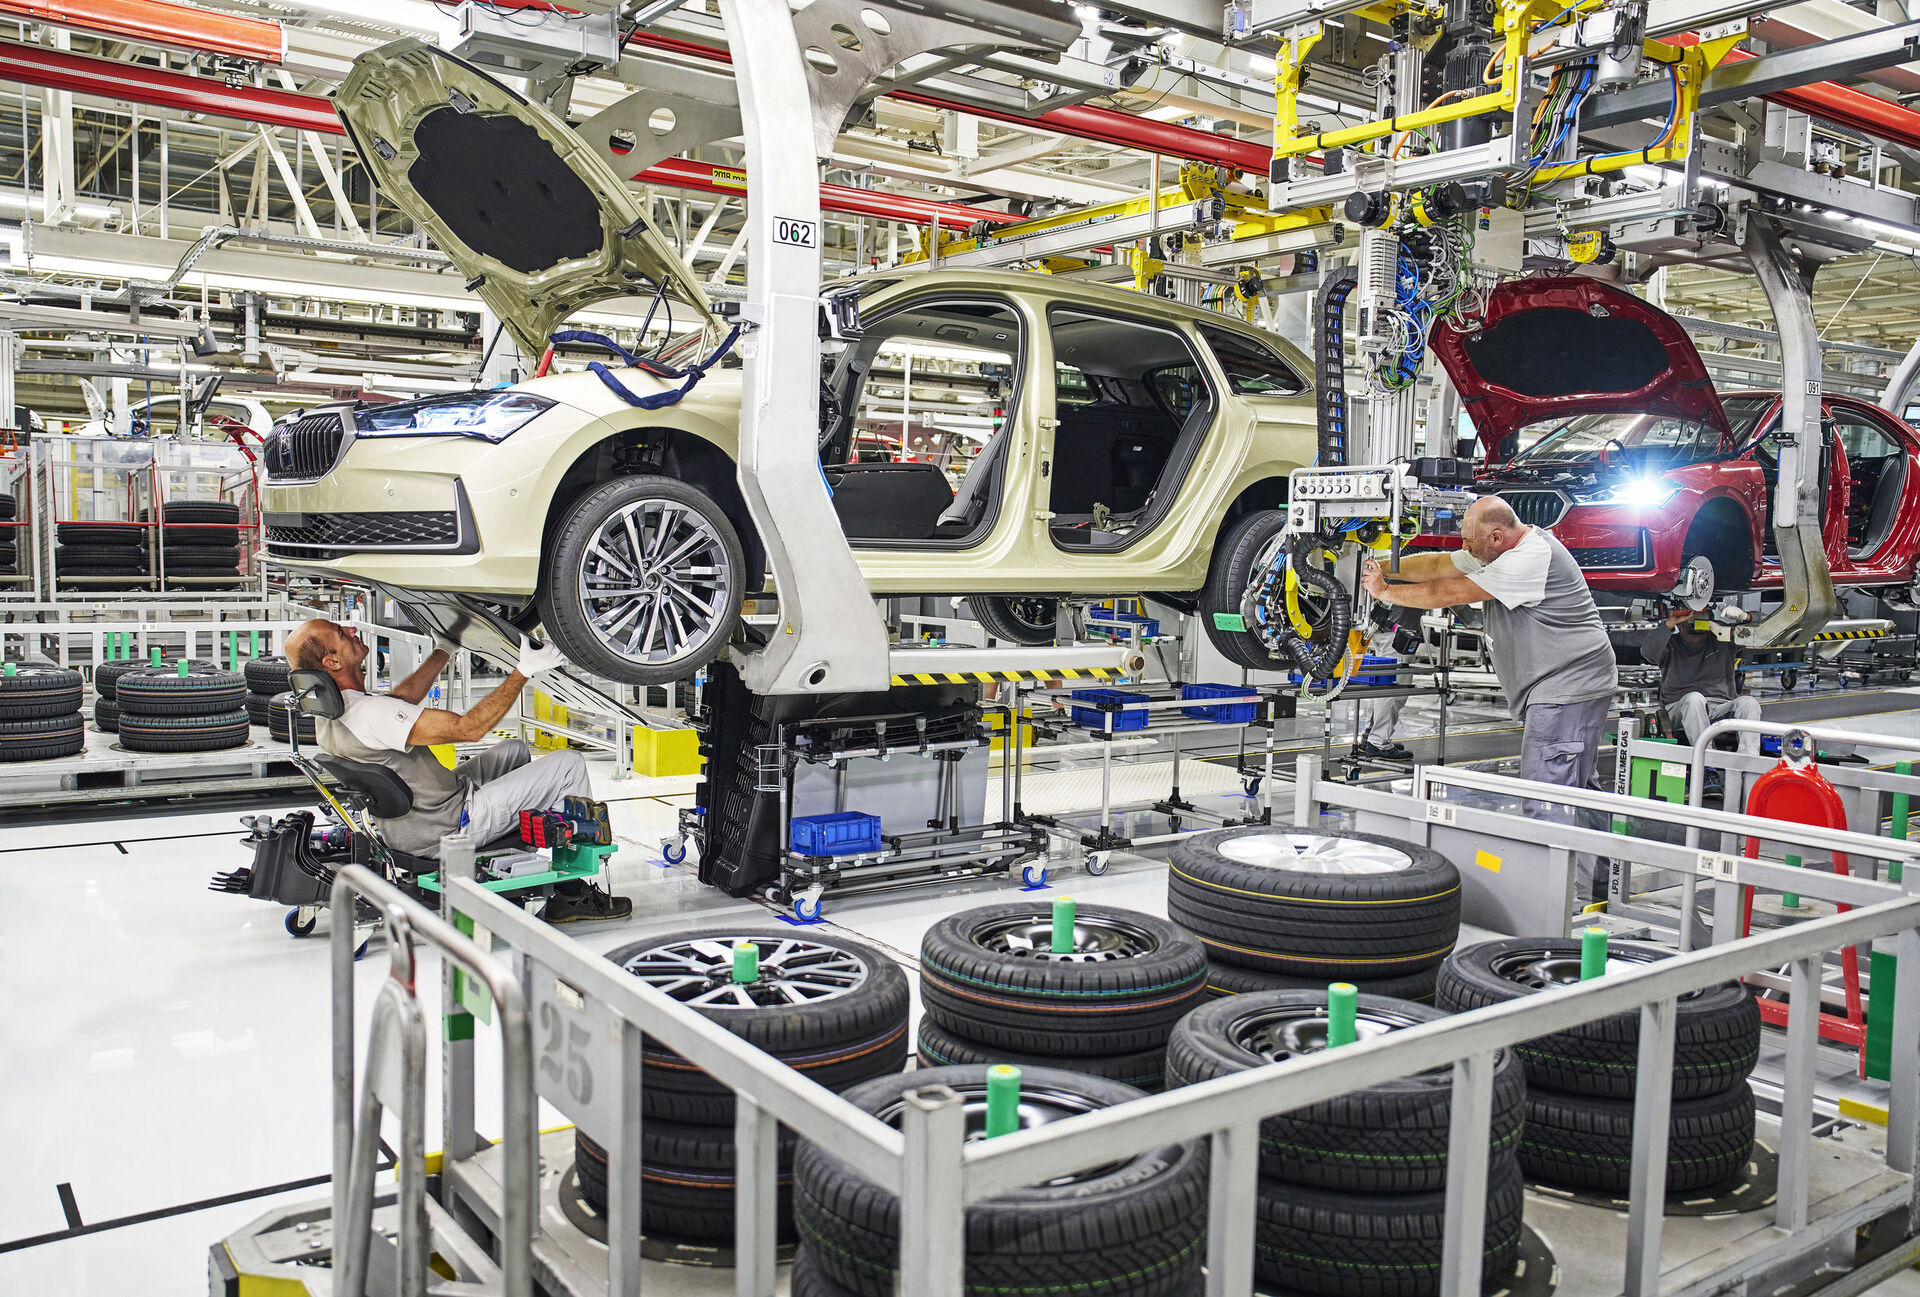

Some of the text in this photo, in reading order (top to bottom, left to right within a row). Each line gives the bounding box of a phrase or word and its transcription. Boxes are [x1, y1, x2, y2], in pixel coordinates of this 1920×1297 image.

[779, 220, 811, 244] 062
[1808, 382, 1819, 394] 091
[1620, 731, 1628, 748] GAS
[541, 1001, 593, 1105] 25
